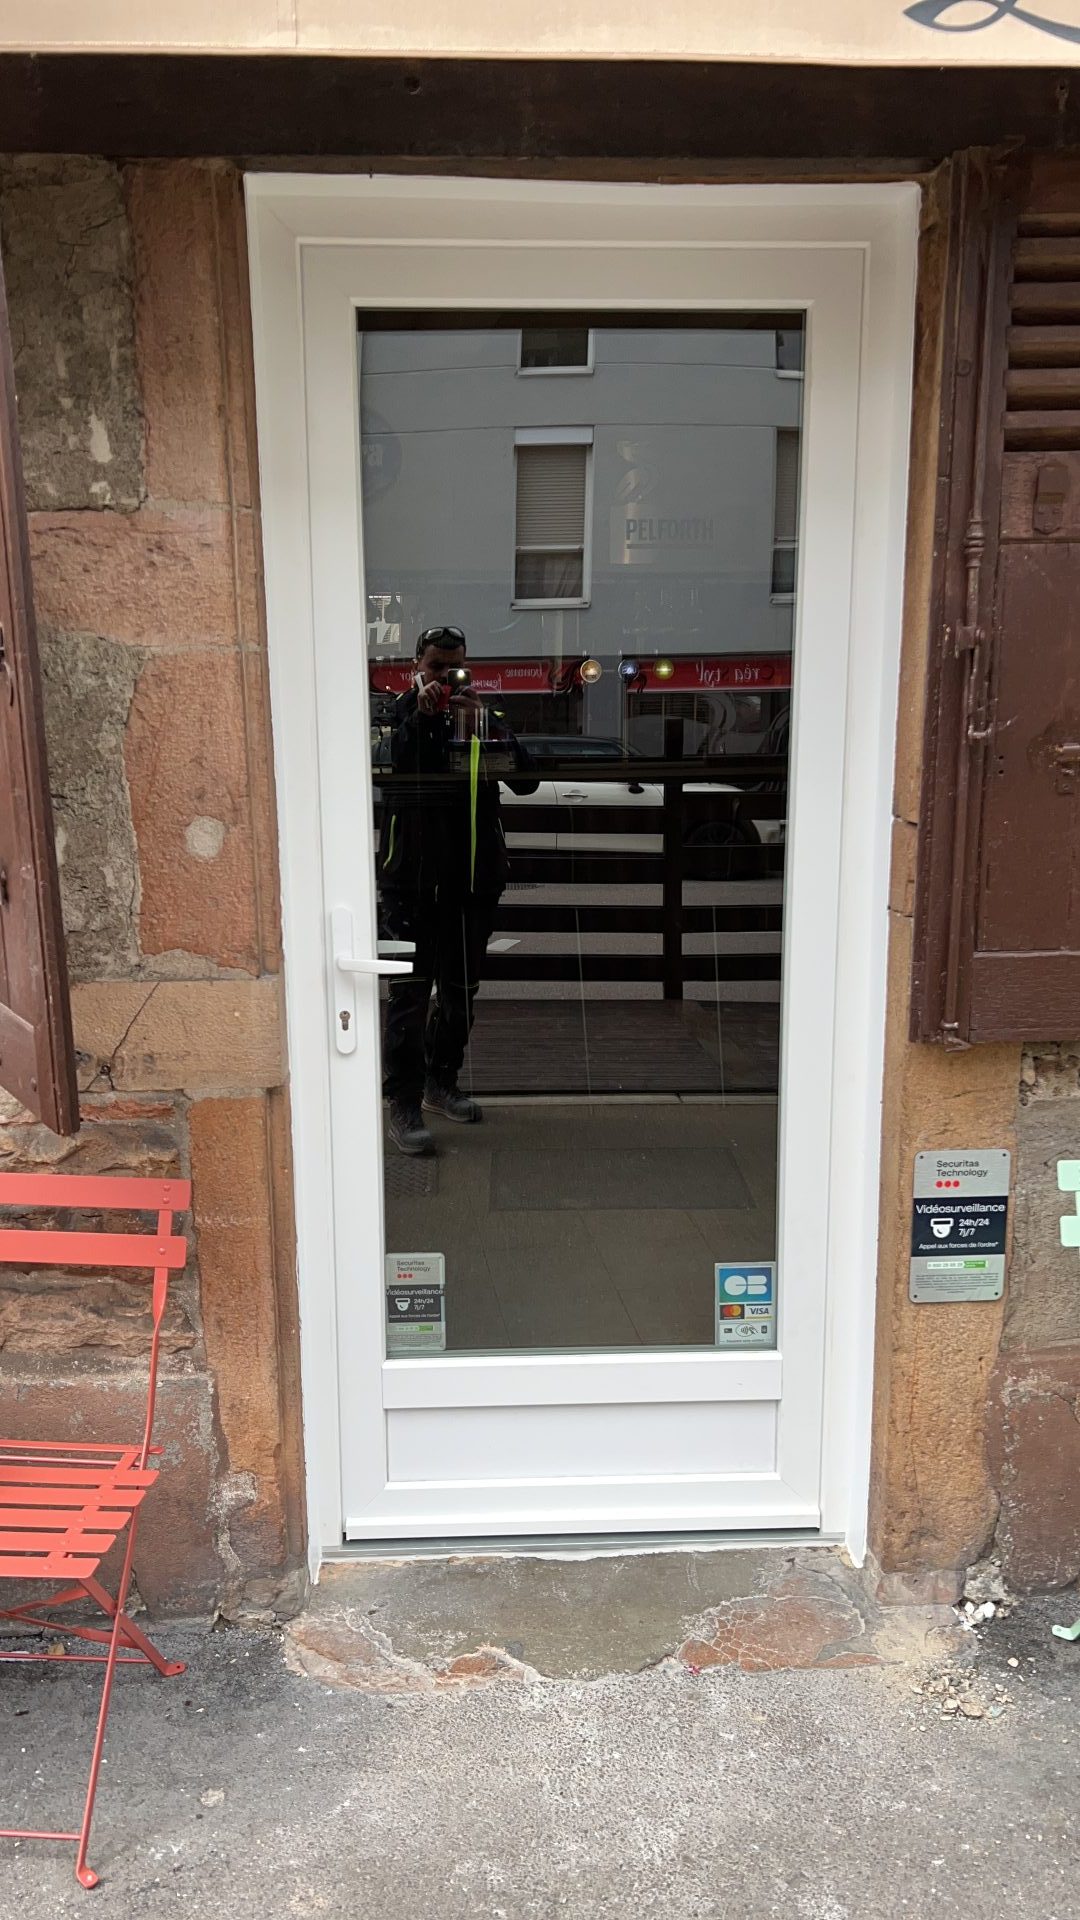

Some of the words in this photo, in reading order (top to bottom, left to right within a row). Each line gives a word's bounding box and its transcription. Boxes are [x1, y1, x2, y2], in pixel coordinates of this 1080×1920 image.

[625, 519, 714, 541] PELFORTH
[936, 1160, 980, 1168] Securitas
[936, 1169, 988, 1178] Technology
[915, 1203, 1006, 1214] Vidéosurveillance
[958, 1218, 990, 1227] 24h/24
[958, 1228, 976, 1238] 7j/7
[386, 1288, 443, 1296] Vidéosurveillance
[749, 1307, 769, 1315] VISA
